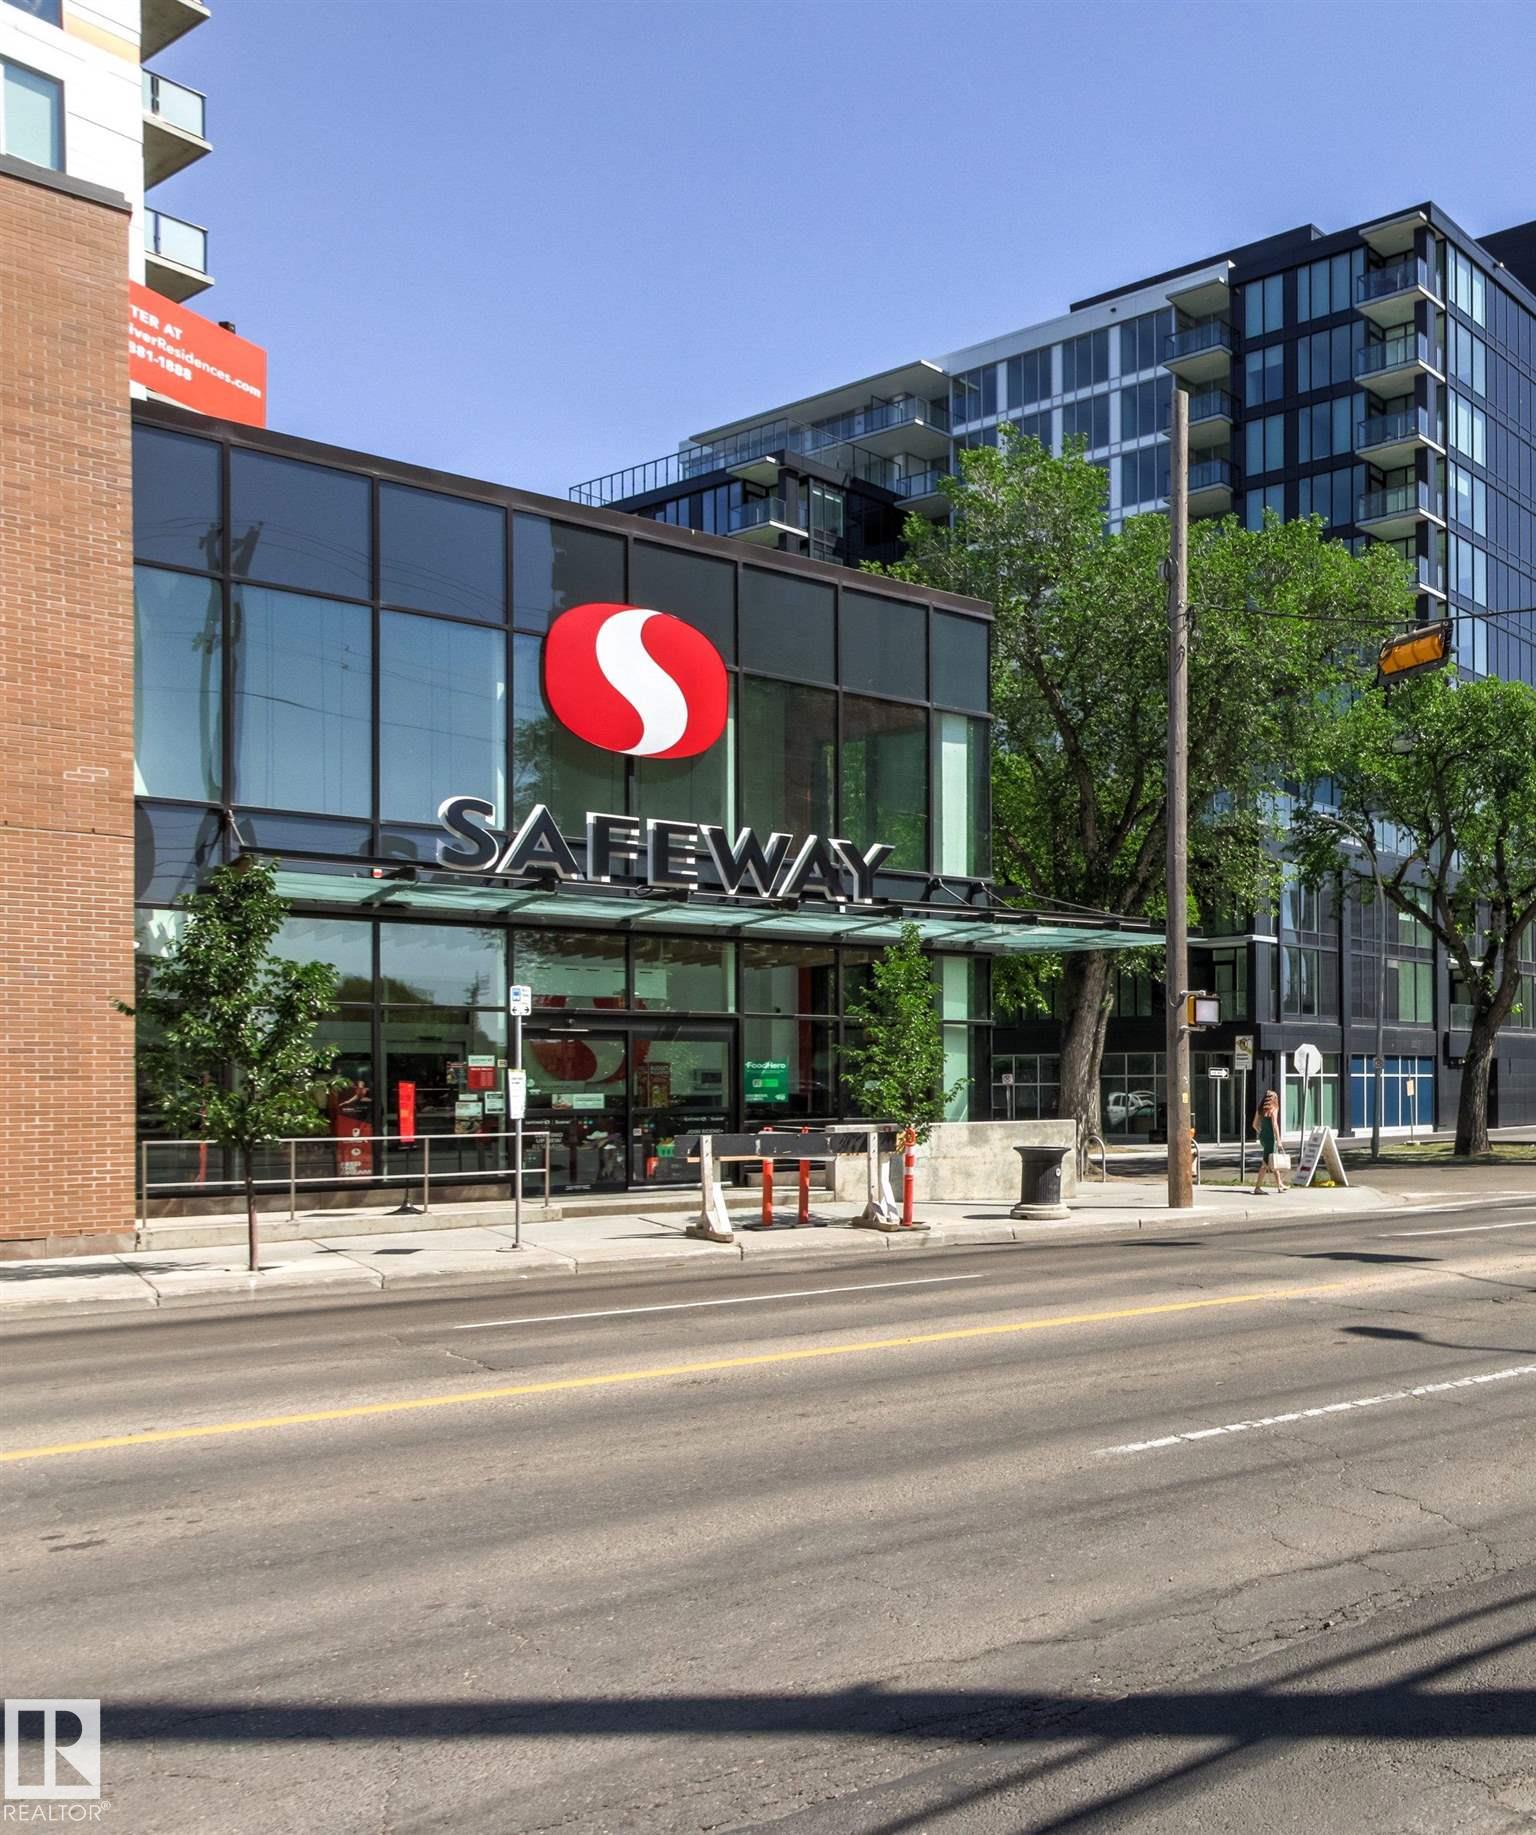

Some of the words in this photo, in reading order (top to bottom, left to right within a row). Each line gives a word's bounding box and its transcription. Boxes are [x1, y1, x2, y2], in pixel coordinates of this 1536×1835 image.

[163, 323, 183, 341] AT
[436, 795, 896, 904] SAFEWAY
[744, 1061, 786, 1069] FoodHero
